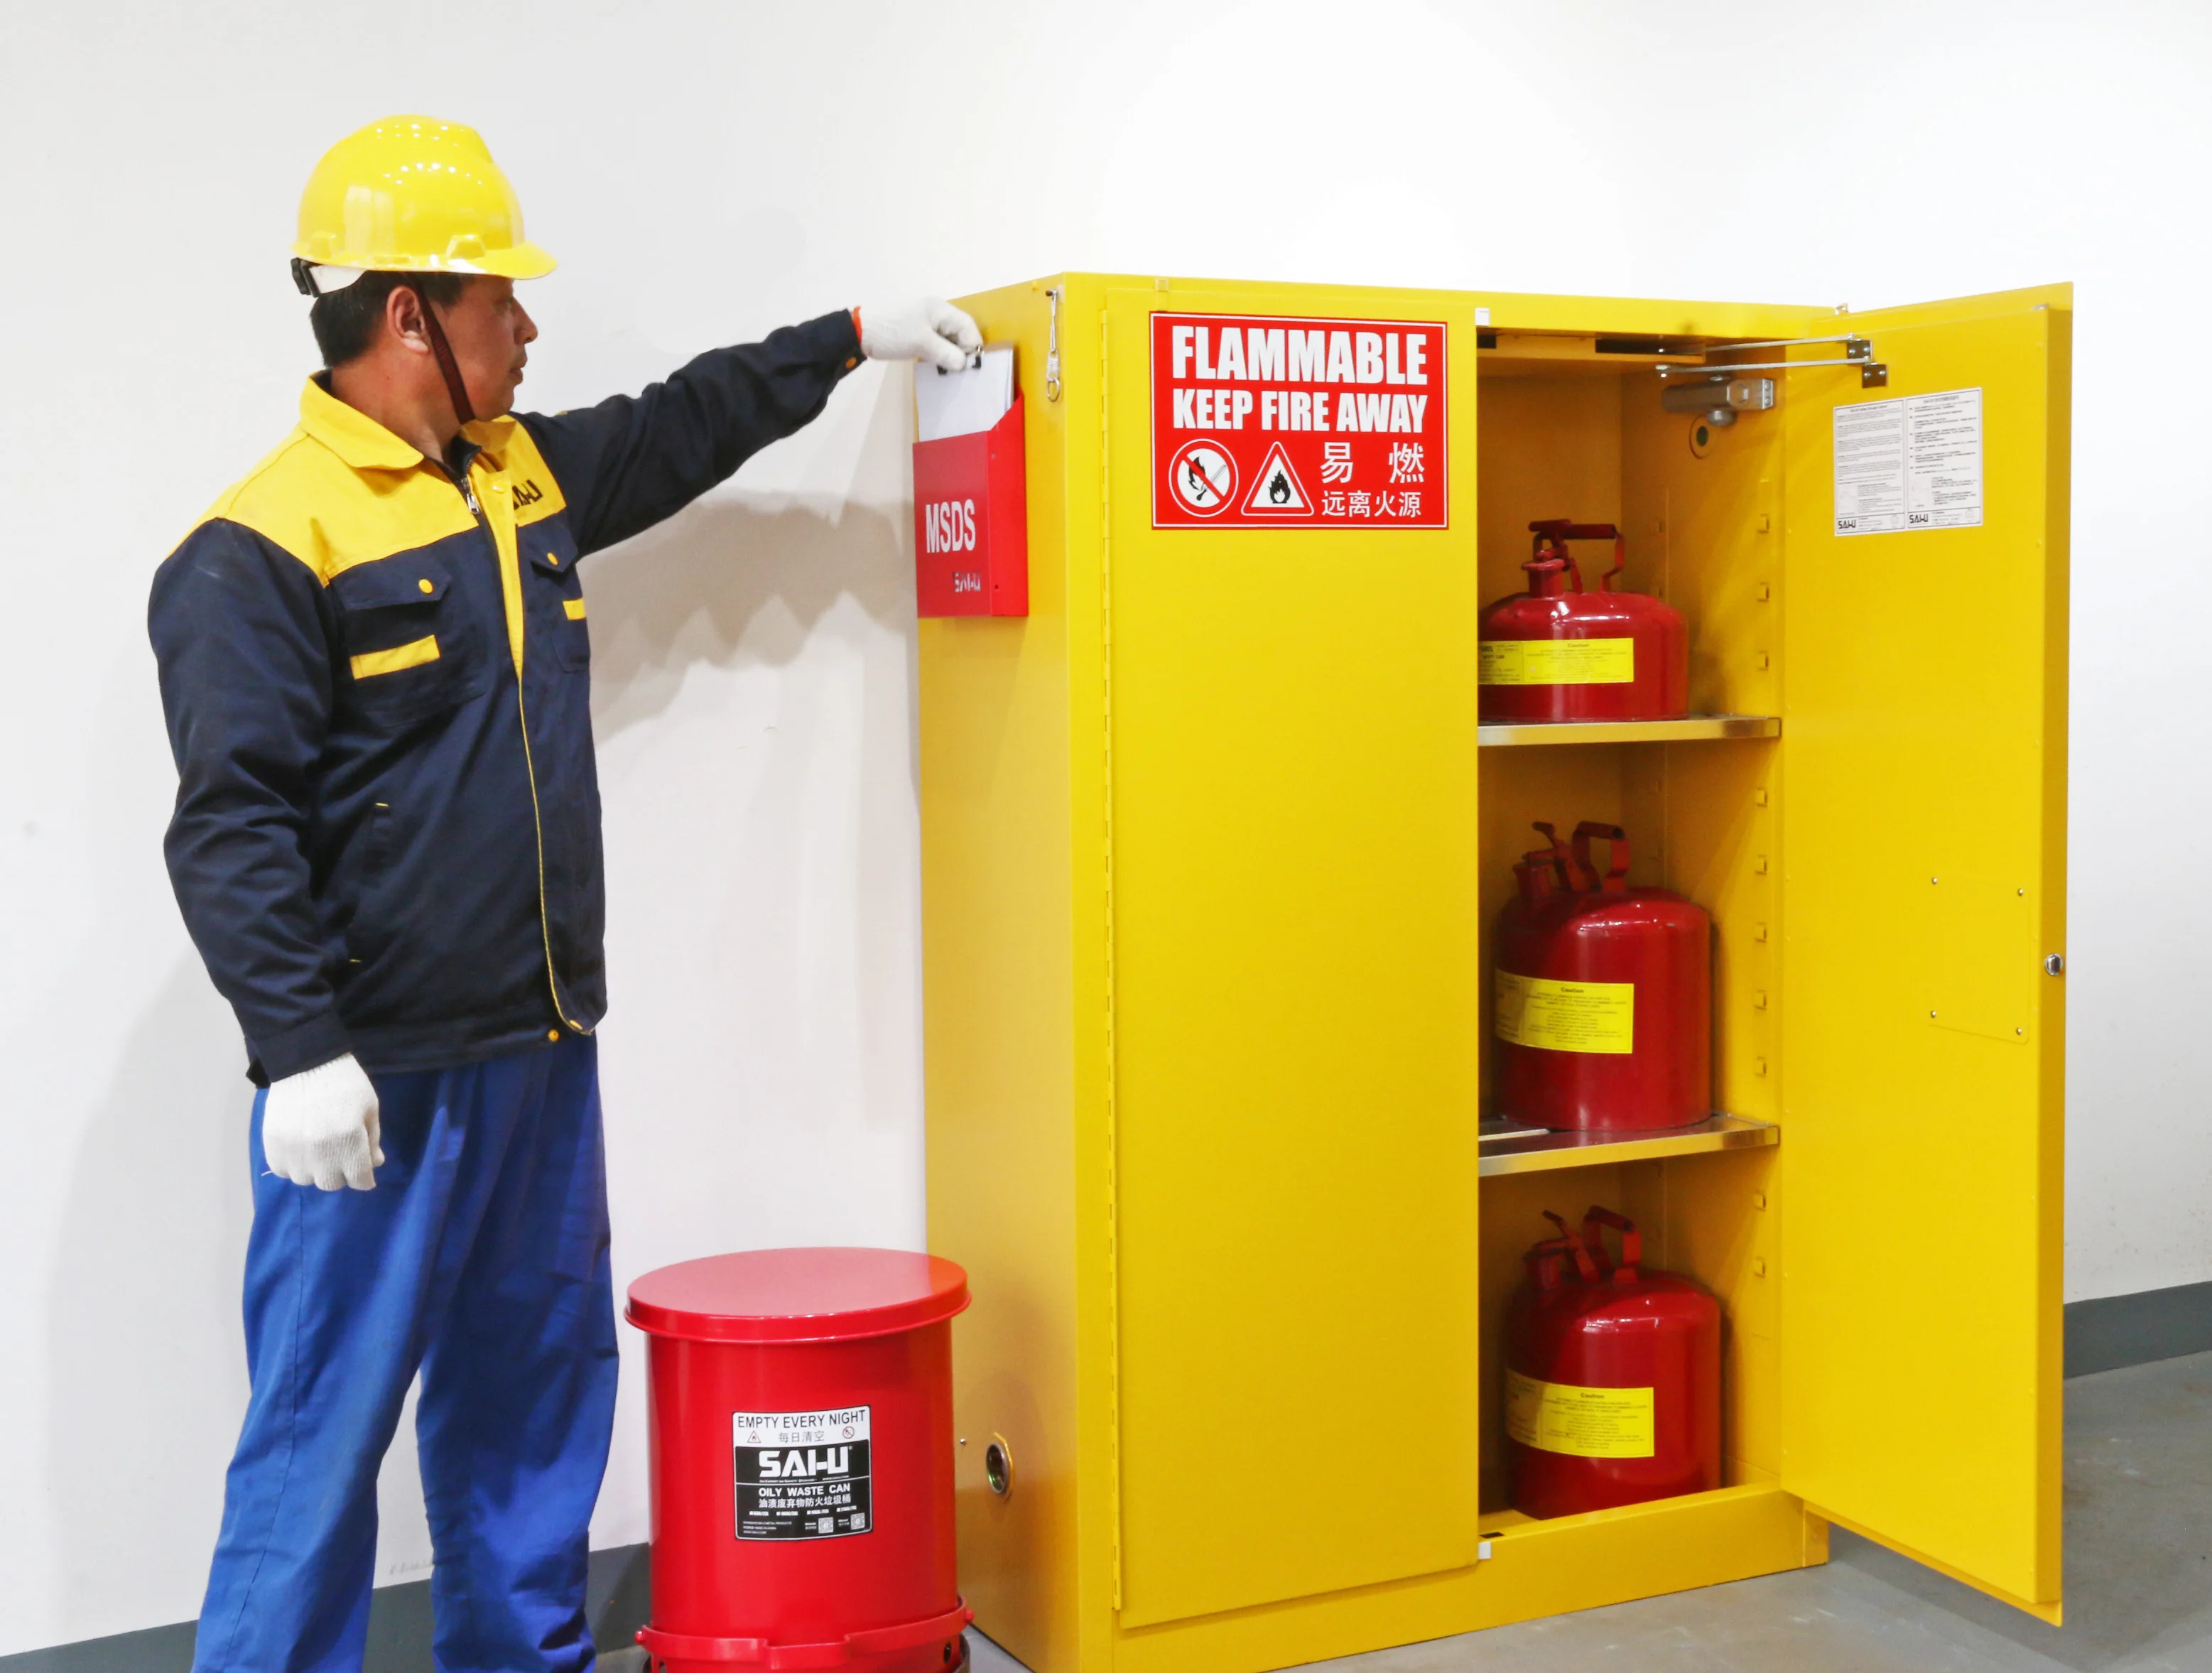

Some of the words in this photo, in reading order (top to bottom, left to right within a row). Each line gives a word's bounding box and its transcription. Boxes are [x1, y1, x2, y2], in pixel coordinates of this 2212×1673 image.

[1172, 325, 1428, 385] FLAMMABLE
[1173, 389, 1253, 430] KEEP
[1262, 391, 1329, 431] FIRE
[1336, 393, 1428, 433] AWAY
[1321, 442, 1425, 484] 易燃
[1321, 490, 1421, 518] 远离火源
[926, 499, 976, 553] MSDS
[738, 1416, 779, 1428] EMPTY
[784, 1414, 825, 1428] EVERY
[830, 1410, 865, 1425] NIGHT
[779, 1431, 825, 1444] 每日清空
[759, 1488, 782, 1497] OILY
[787, 1486, 824, 1496] WASTE
[829, 1483, 850, 1493] CAN
